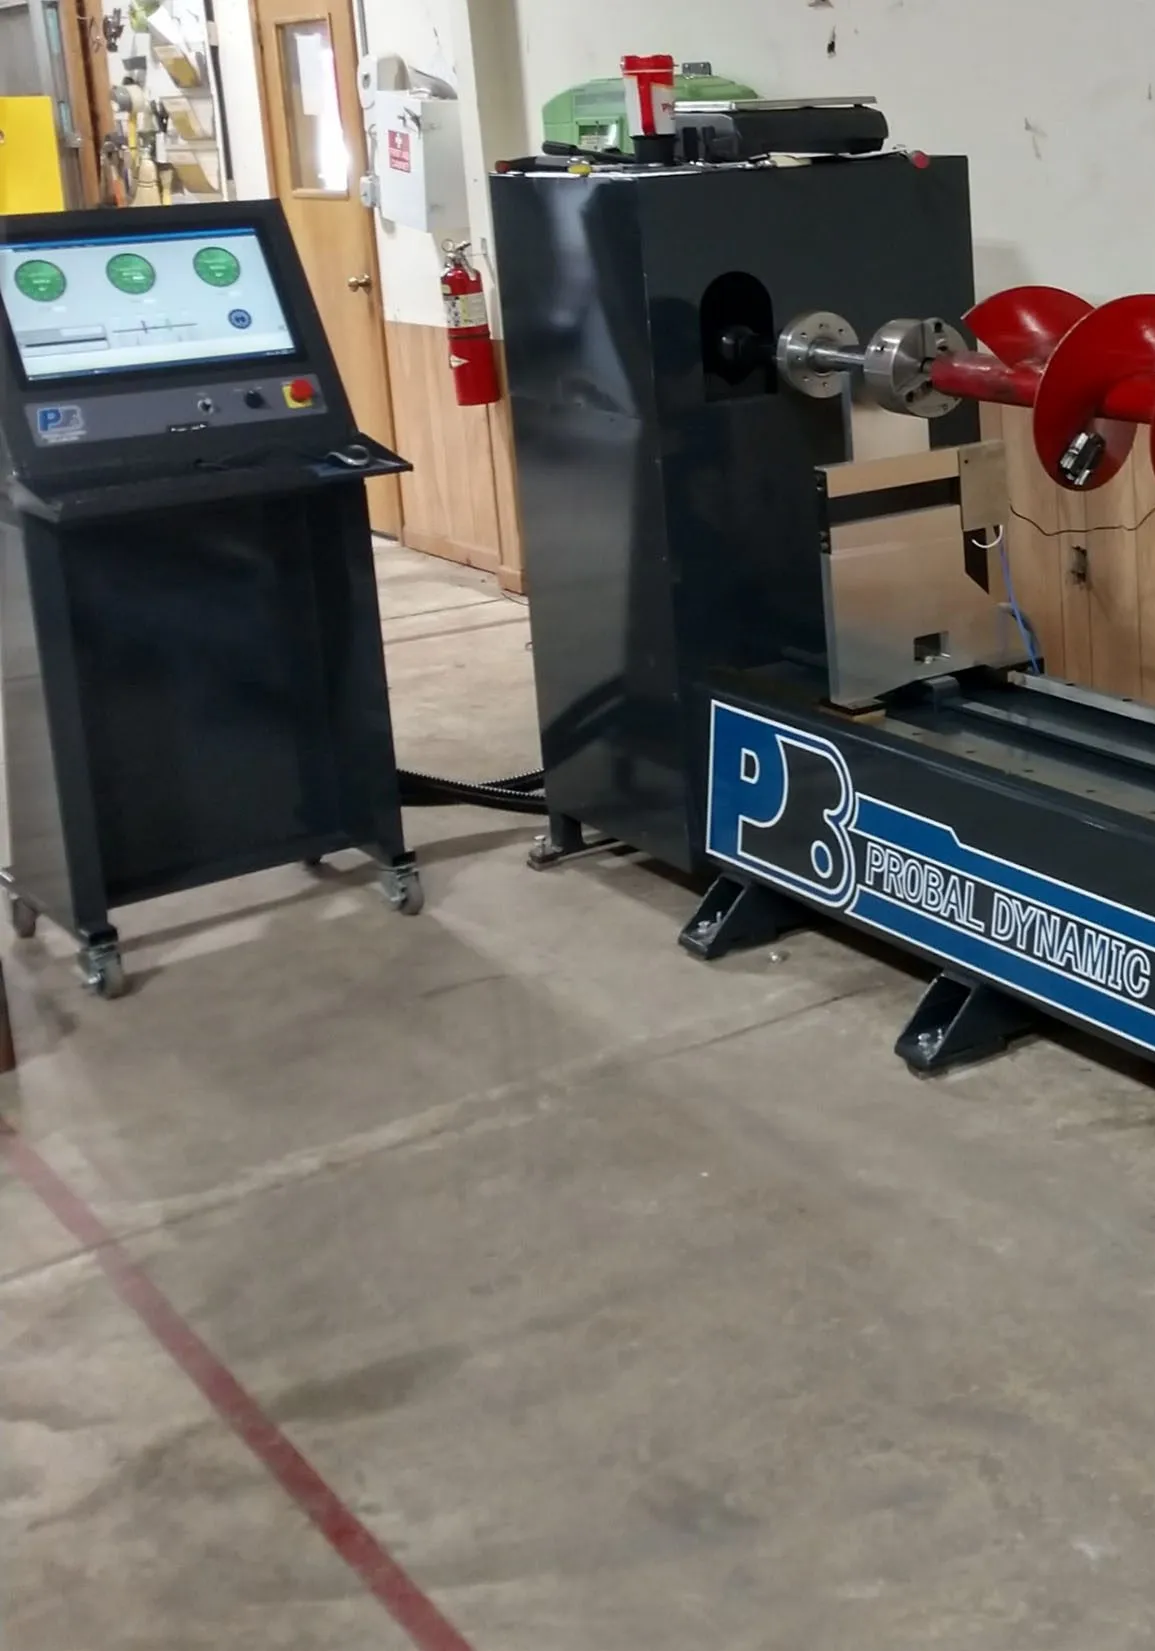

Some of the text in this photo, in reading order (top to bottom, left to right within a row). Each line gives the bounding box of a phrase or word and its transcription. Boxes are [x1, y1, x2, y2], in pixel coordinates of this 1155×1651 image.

[706, 700, 856, 907] PB
[865, 841, 985, 934] PROBAL
[991, 892, 1151, 999] DYNAMIC
